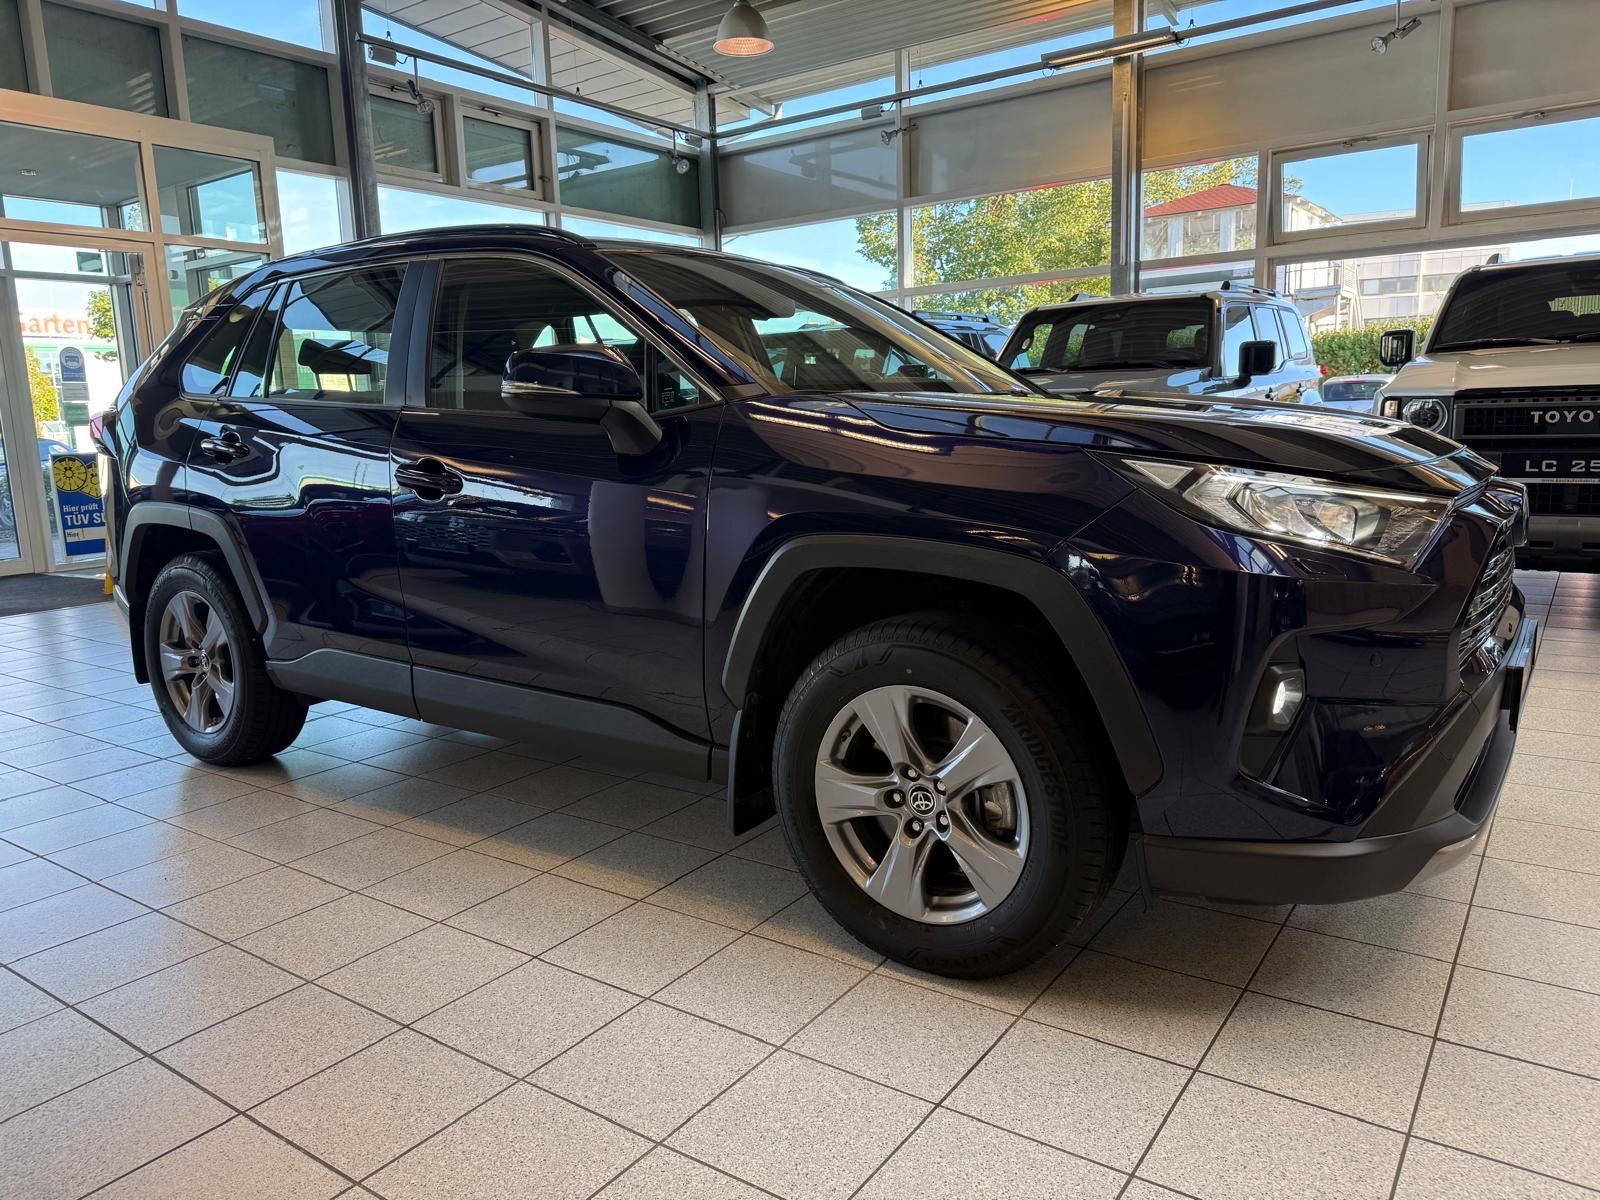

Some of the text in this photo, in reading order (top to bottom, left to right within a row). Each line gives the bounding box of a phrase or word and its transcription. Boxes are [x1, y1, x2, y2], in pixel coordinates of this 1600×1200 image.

[1530, 409, 1600, 424] TOYO
[1525, 459, 1558, 473] LC
[63, 503, 99, 512] Hier prüft
[65, 512, 89, 526] TÜV
[1000, 704, 1069, 857] BRIDGESTONE
